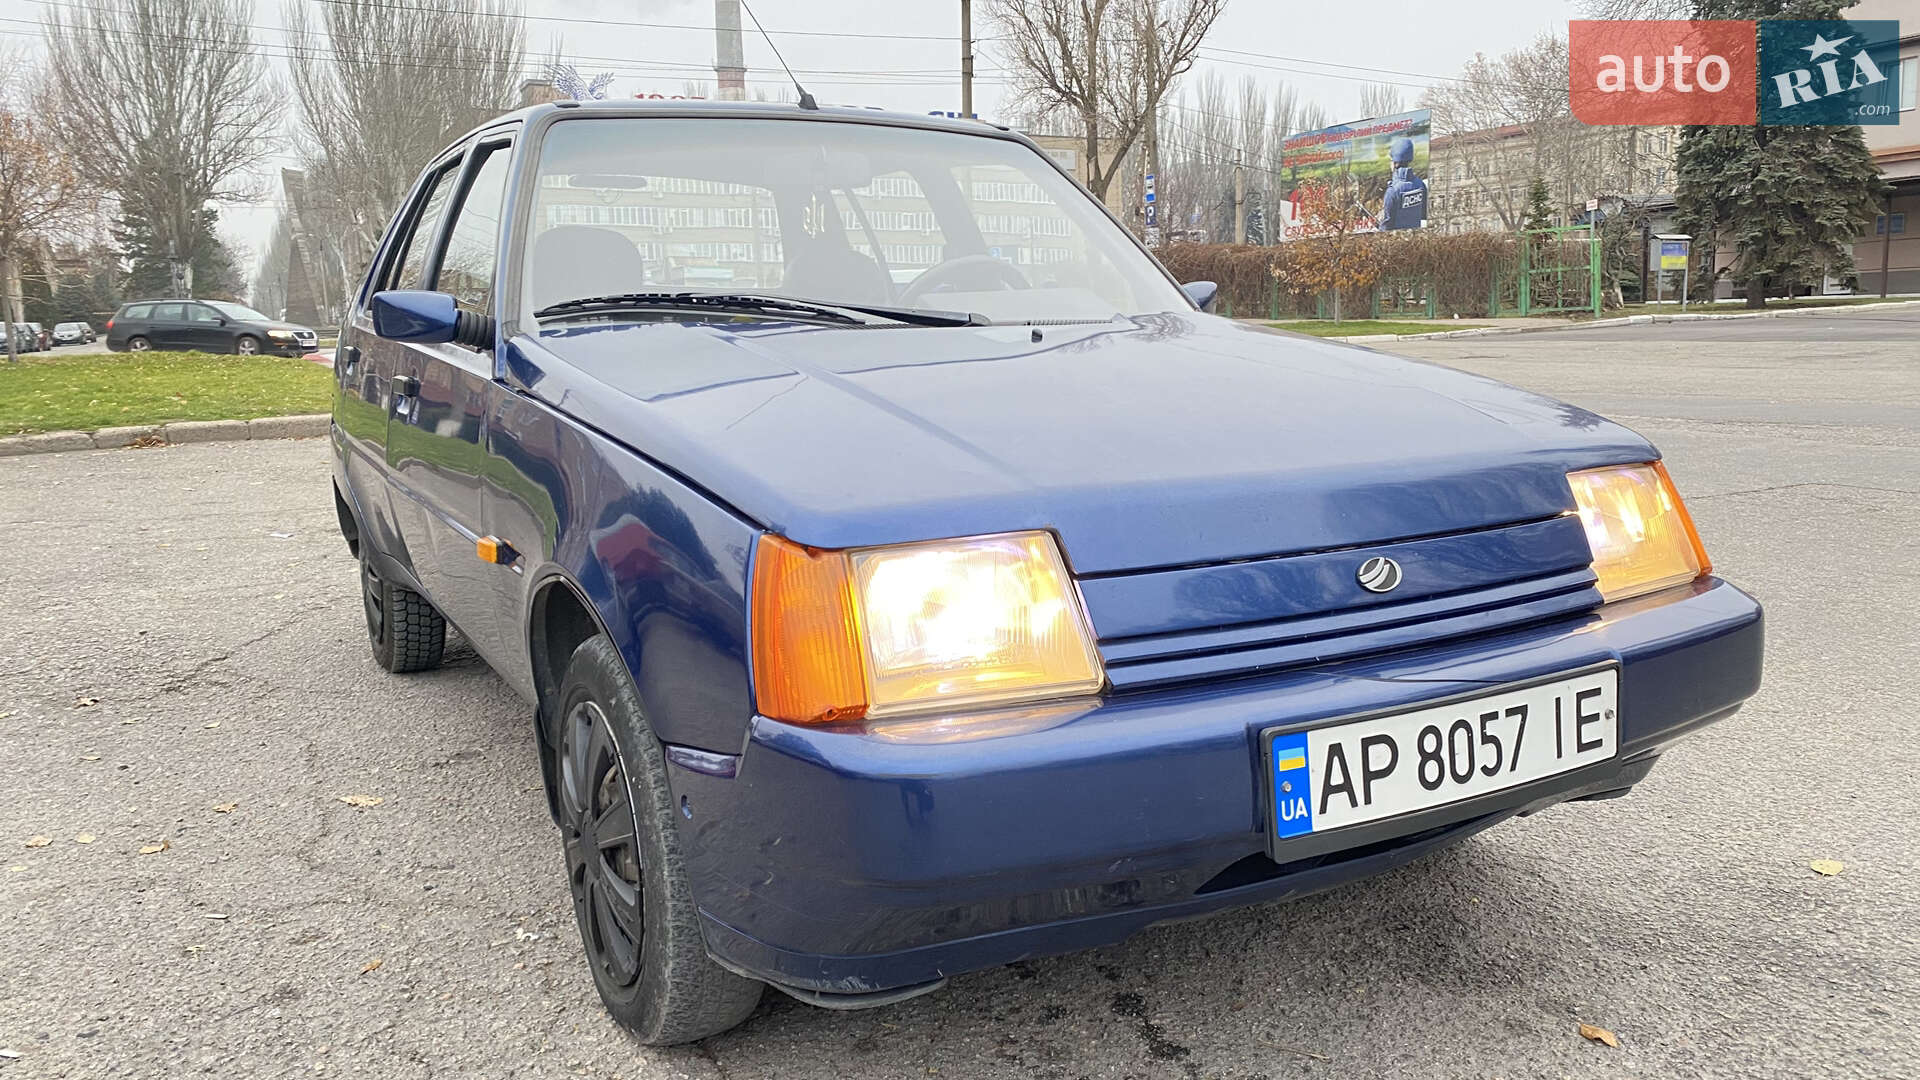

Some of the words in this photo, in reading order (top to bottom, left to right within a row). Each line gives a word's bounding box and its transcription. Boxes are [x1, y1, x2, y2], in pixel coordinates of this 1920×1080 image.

[1402, 193, 1422, 208] ДСНС
[1318, 734, 1399, 815] AP
[1416, 704, 1529, 791] 8057
[1555, 686, 1604, 760] IE
[1280, 797, 1309, 822] UA
